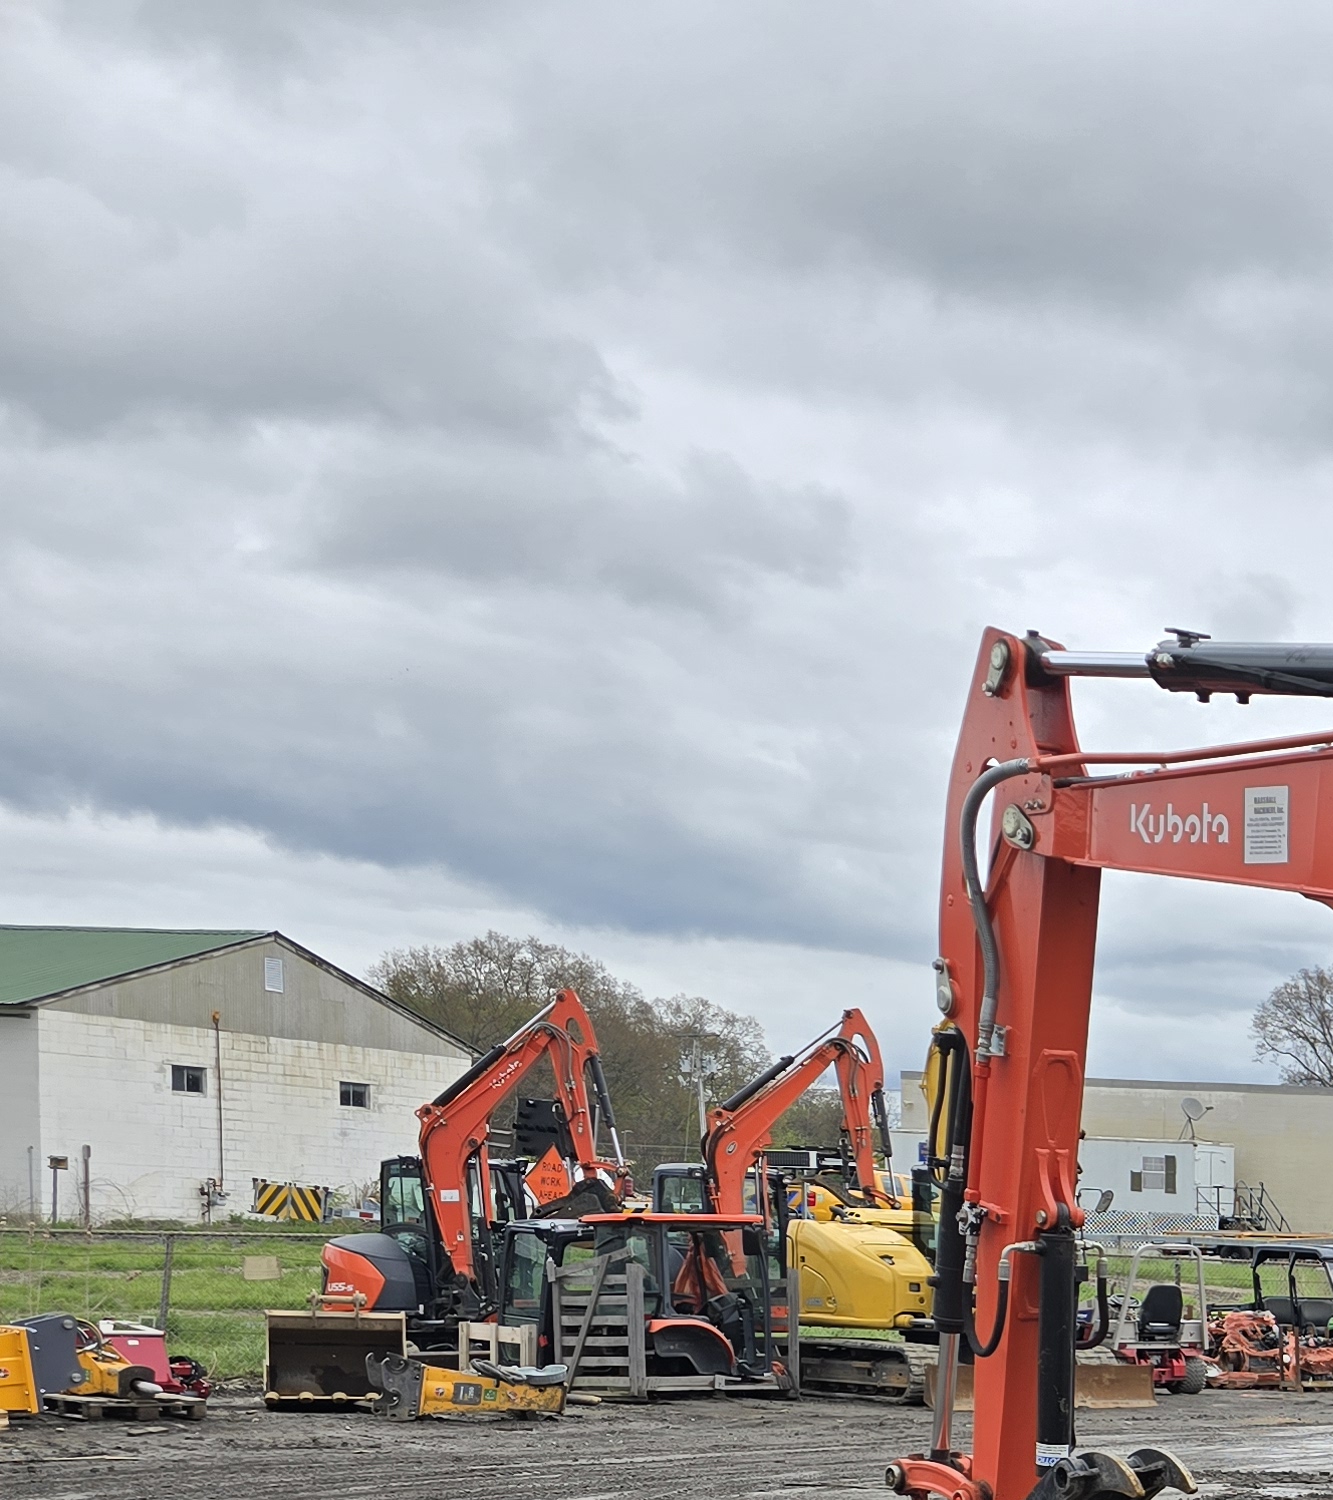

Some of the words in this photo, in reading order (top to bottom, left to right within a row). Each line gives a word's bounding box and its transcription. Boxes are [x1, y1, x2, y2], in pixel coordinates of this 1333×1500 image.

[1130, 802, 1230, 844] Kubota
[541, 1161, 563, 1173] ROAD
[540, 1176, 561, 1187] WORK
